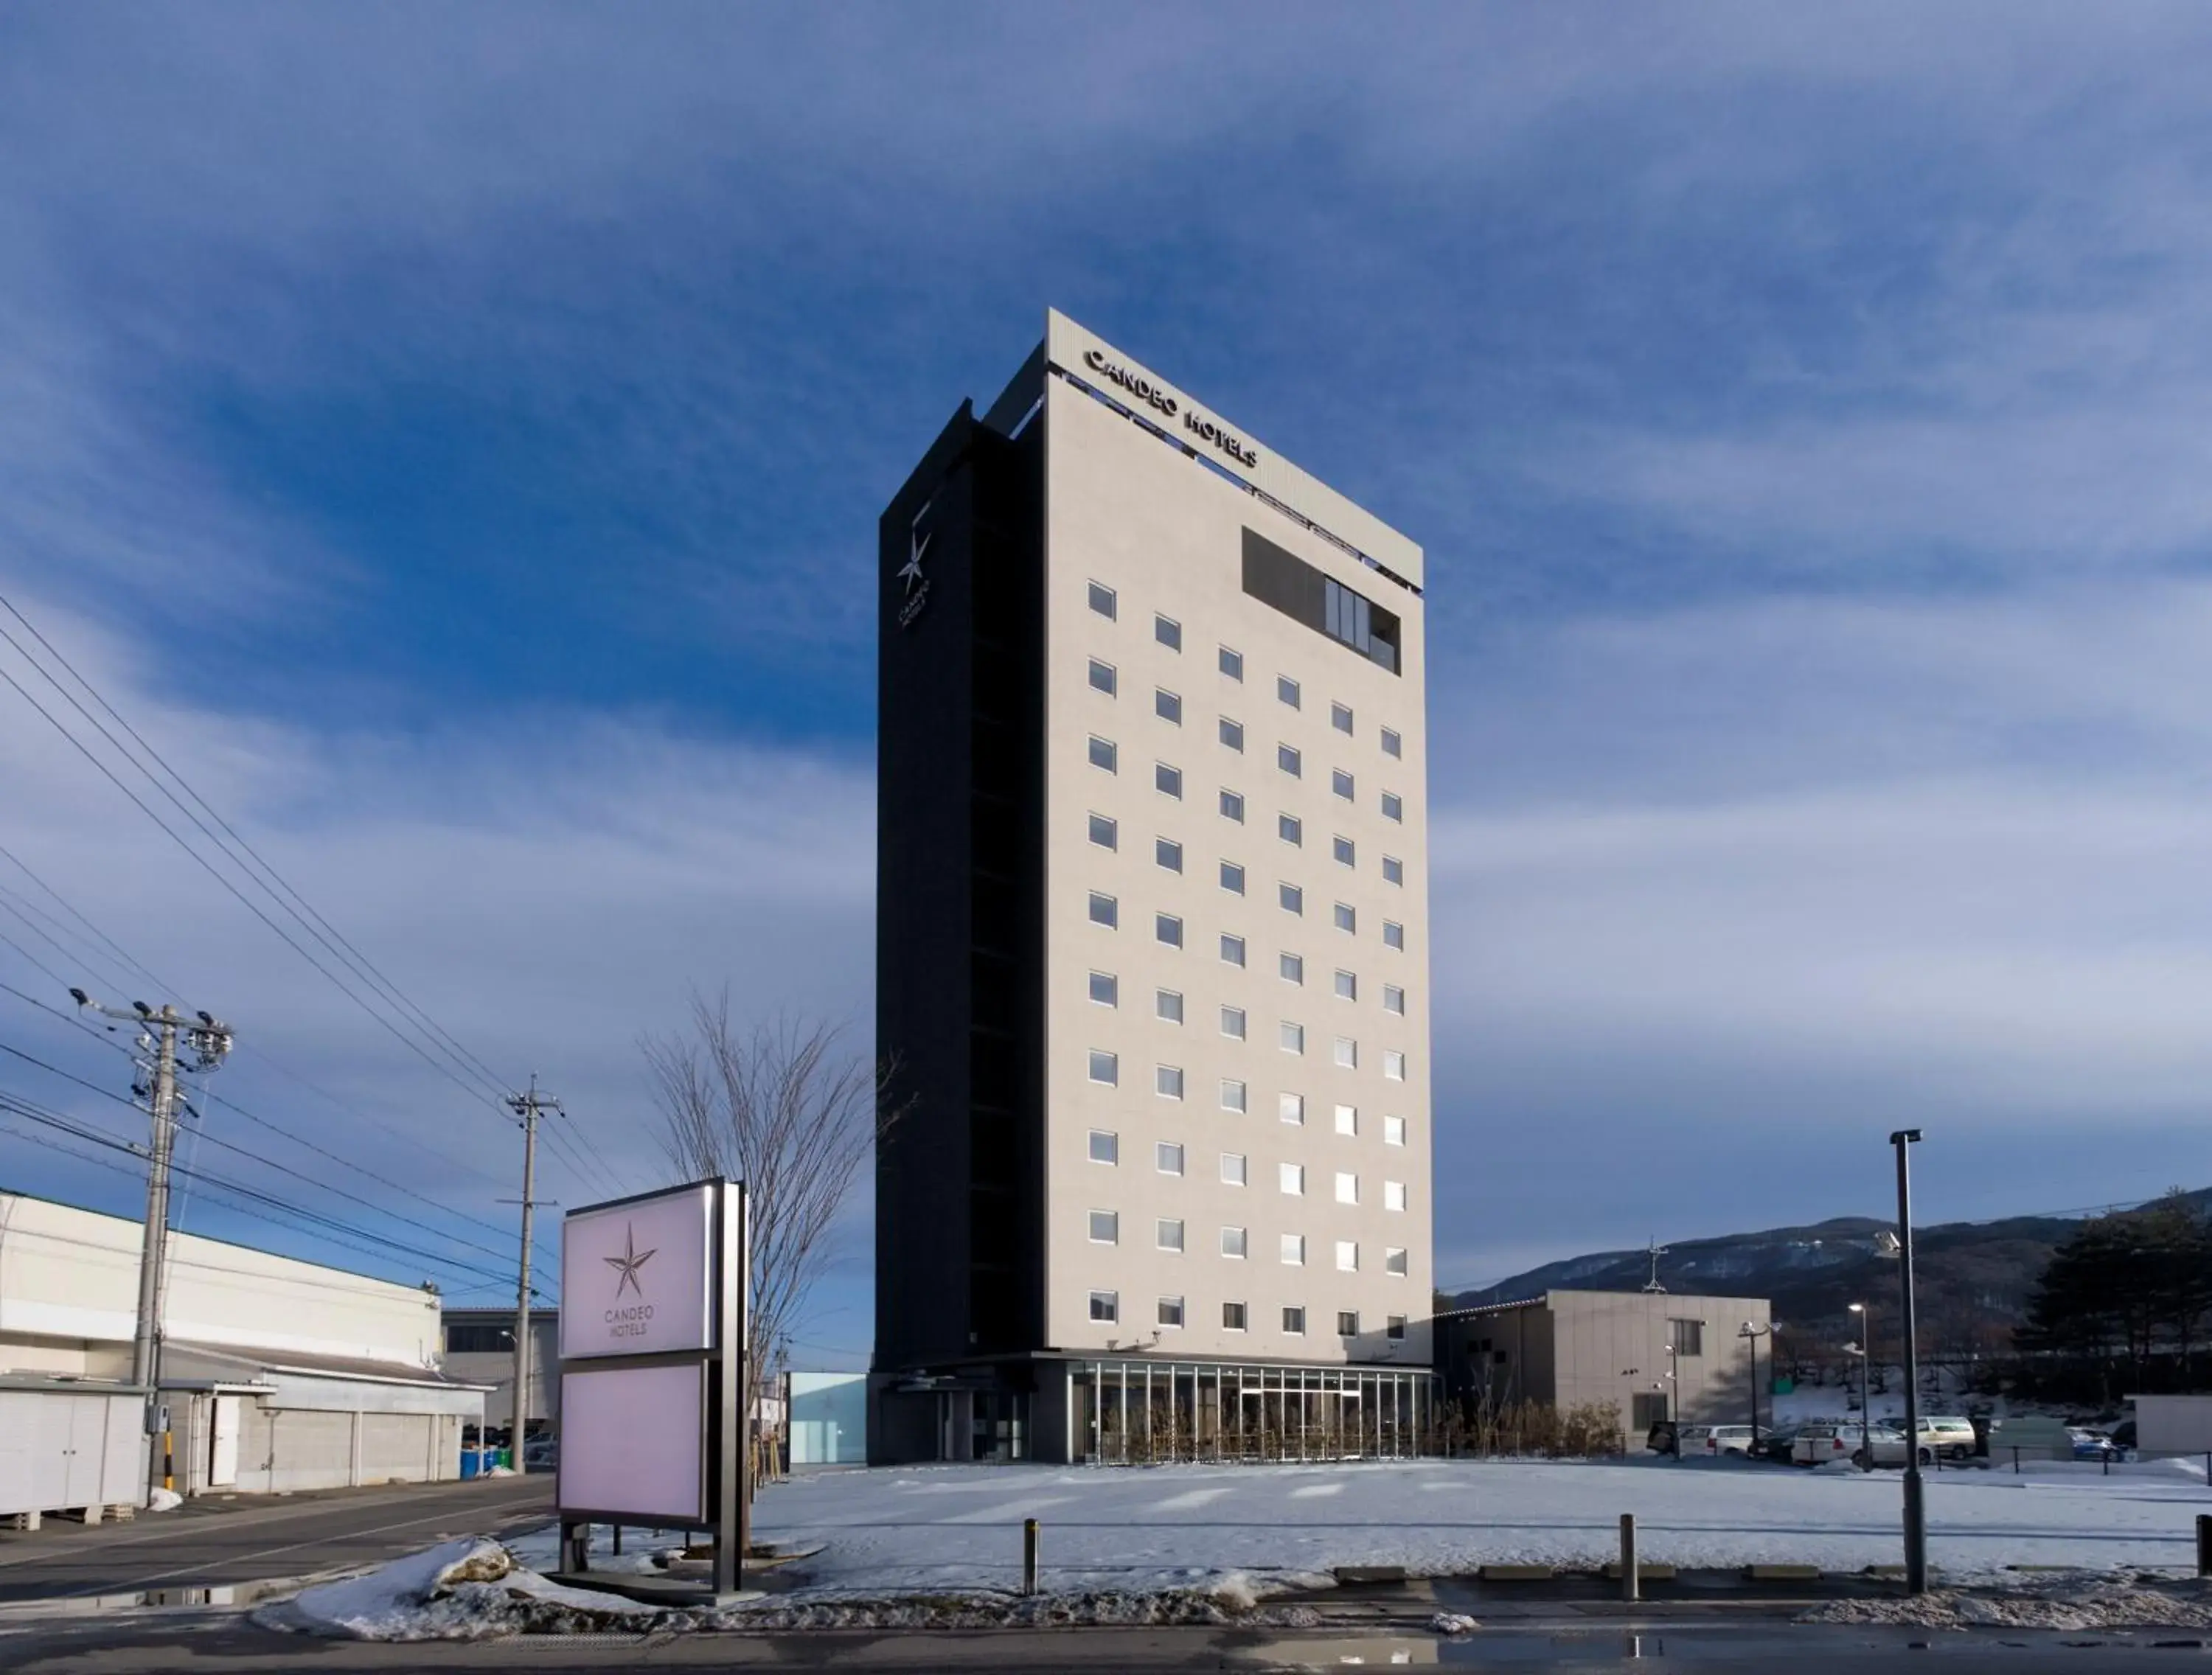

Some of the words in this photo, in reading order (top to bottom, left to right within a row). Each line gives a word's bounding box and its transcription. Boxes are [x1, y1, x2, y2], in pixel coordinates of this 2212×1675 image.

[1083, 350, 1178, 417] CANDEO
[1184, 411, 1256, 468] HOTELS
[605, 1305, 654, 1323] CANDEO
